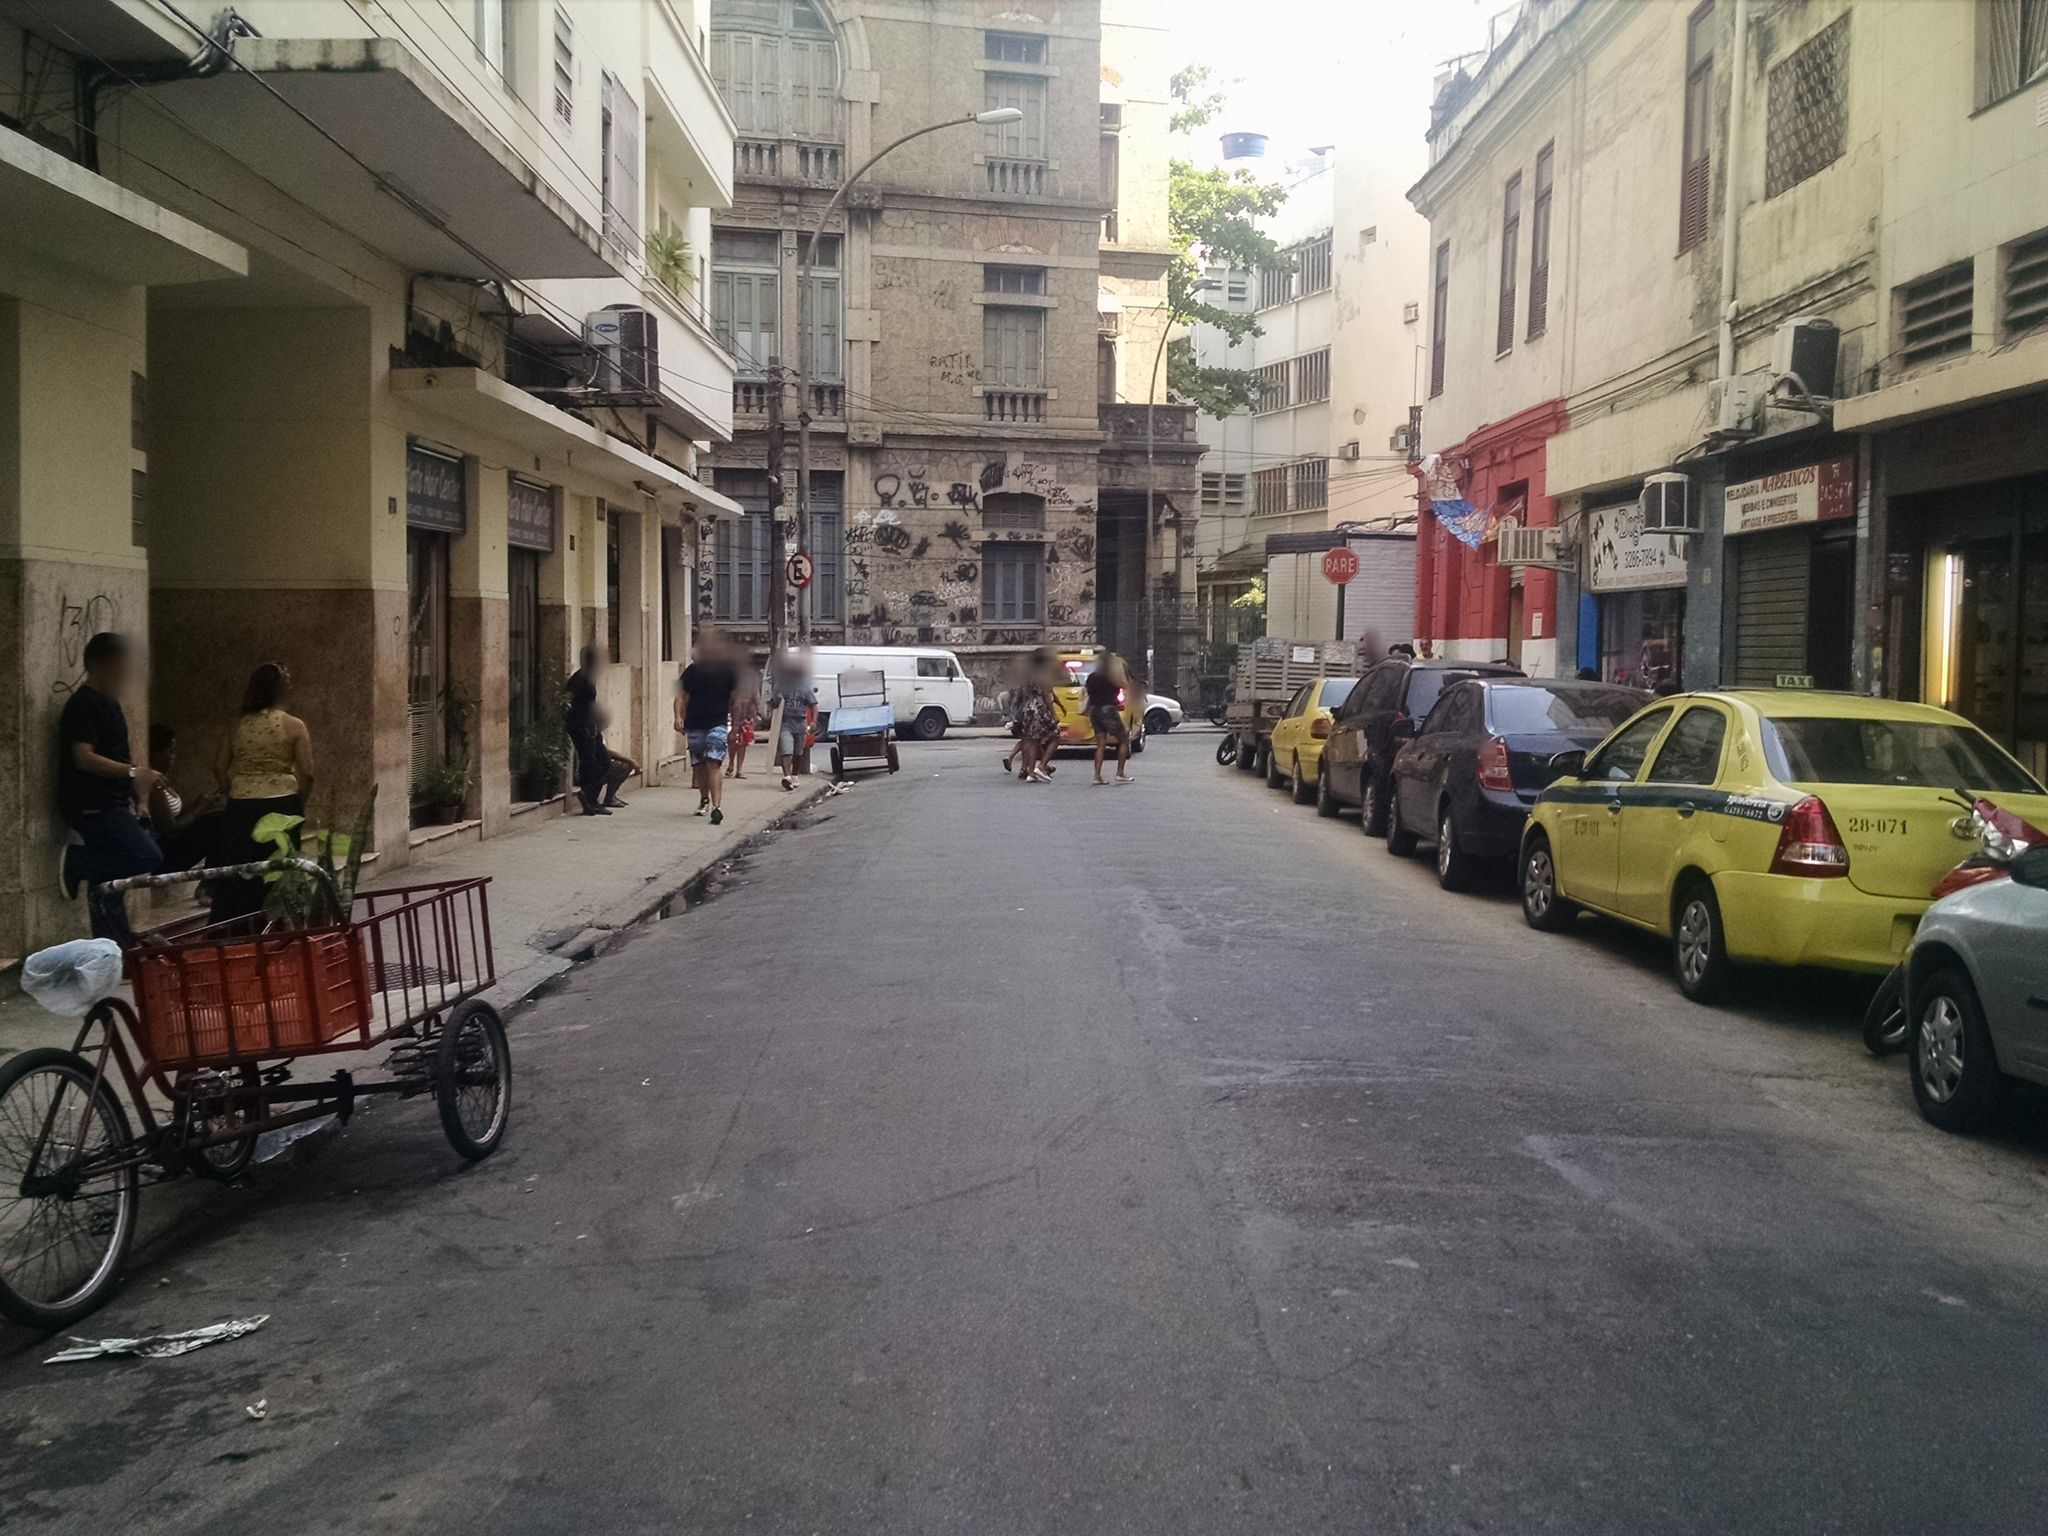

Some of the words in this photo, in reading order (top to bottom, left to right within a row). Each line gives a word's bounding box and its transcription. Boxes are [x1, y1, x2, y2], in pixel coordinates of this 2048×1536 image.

[793, 559, 804, 581] E
[1325, 557, 1356, 574] PARE
[1779, 675, 1813, 688] TAXI
[1848, 816, 1907, 836] 28-071
